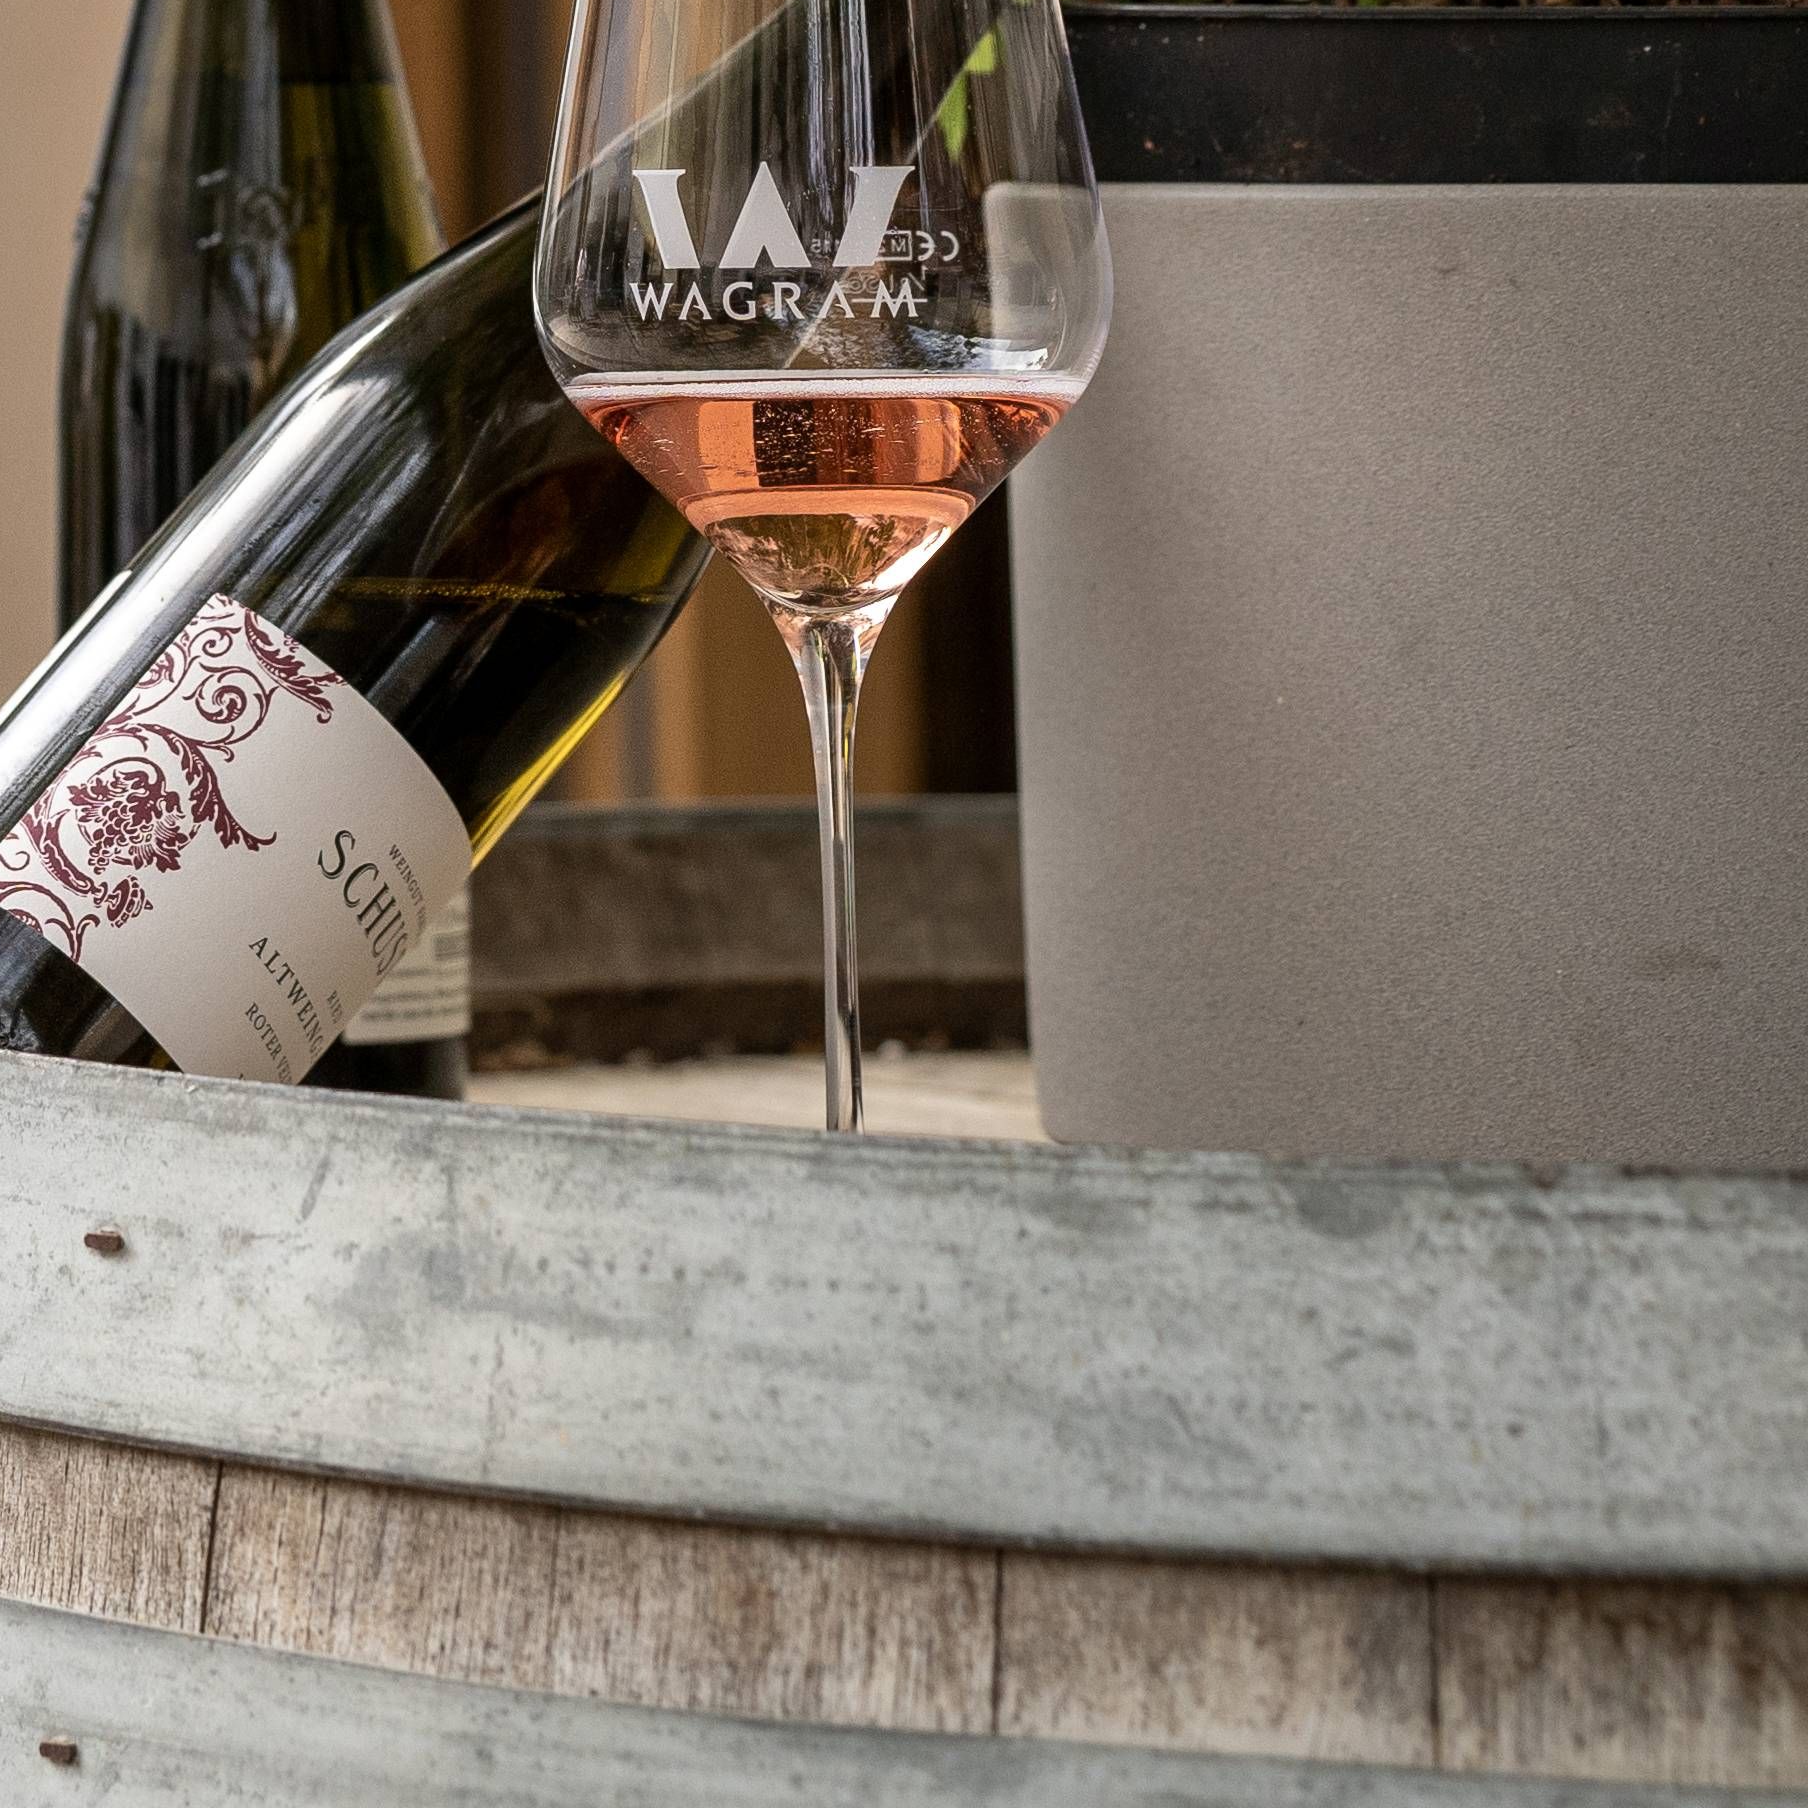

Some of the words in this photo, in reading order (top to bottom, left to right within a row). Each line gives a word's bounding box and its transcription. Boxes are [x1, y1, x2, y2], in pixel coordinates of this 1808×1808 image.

[629, 281, 919, 321] WAGRAM
[388, 843, 425, 908] WEINGUT
[248, 936, 323, 1058] ALTWEING
[244, 1001, 283, 1059] ROTER
